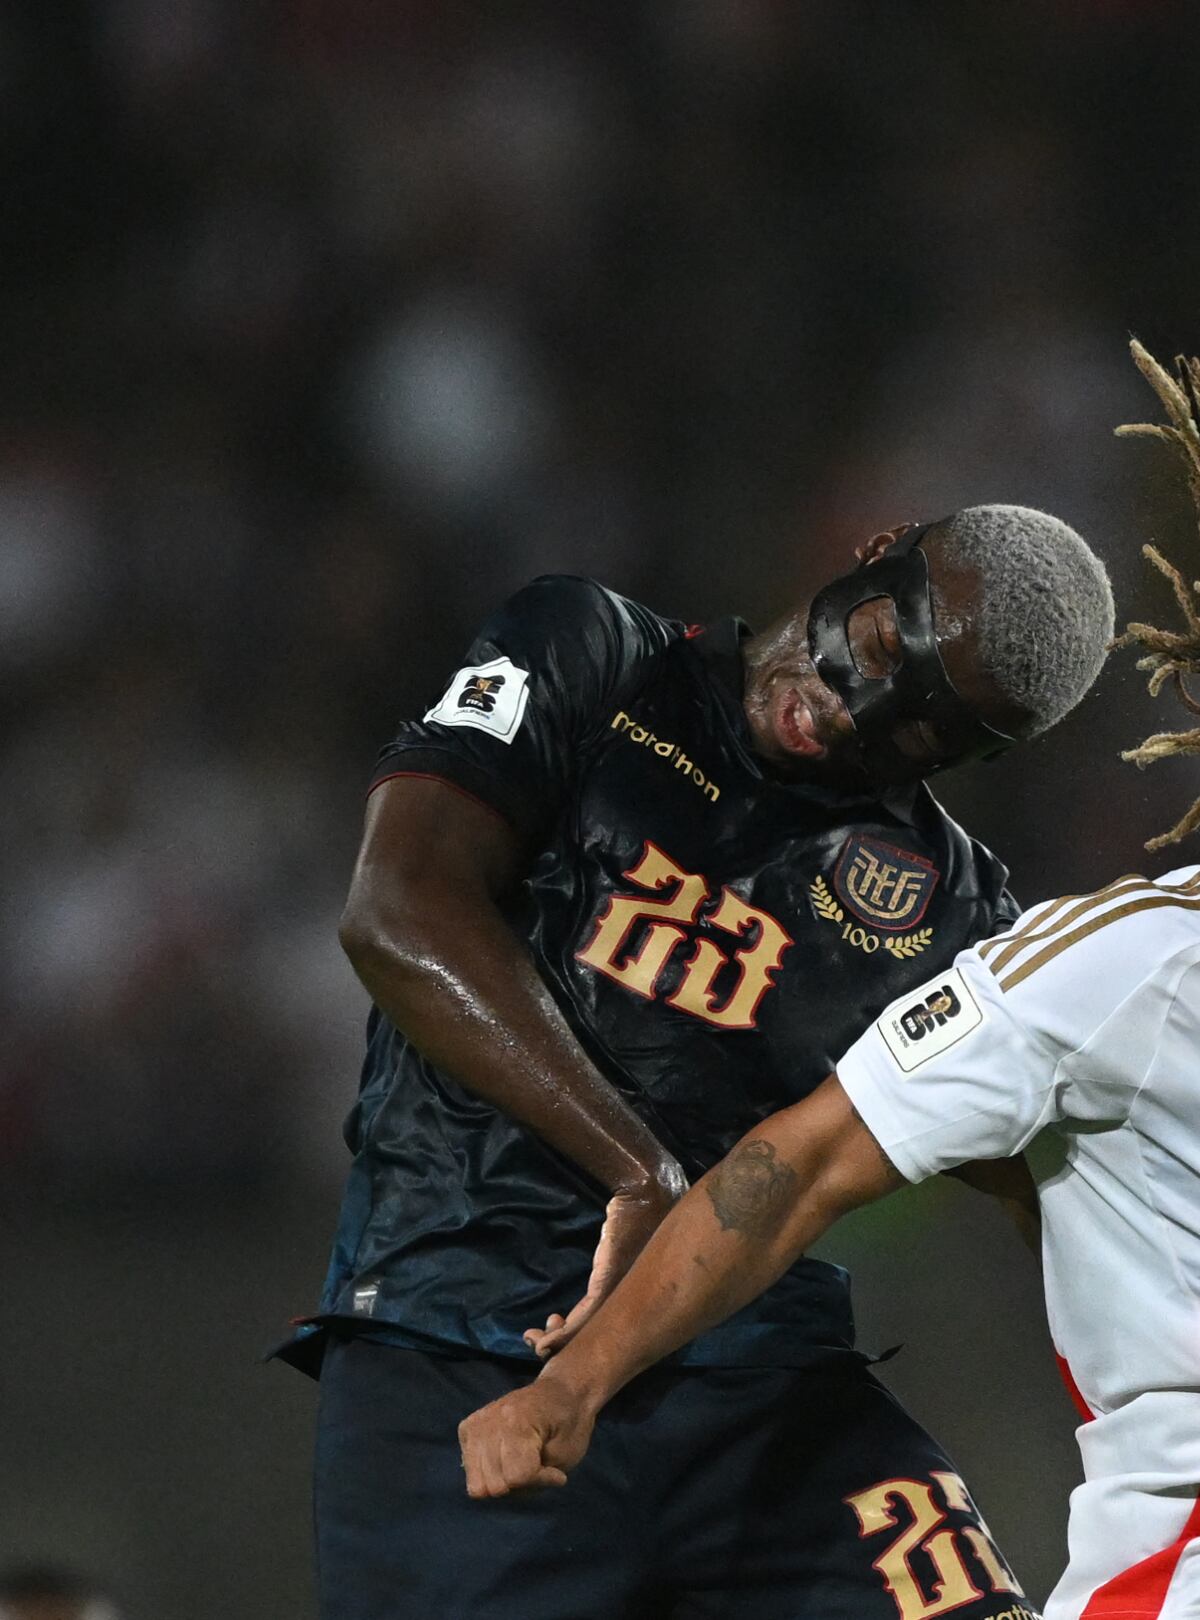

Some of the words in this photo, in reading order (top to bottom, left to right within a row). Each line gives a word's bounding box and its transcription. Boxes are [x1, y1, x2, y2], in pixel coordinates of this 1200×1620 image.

[466, 699, 484, 708] FIFA
[610, 711, 721, 802] marathon
[575, 840, 794, 1030] 23
[841, 922, 880, 954] 100
[906, 1016, 918, 1034] FIFA
